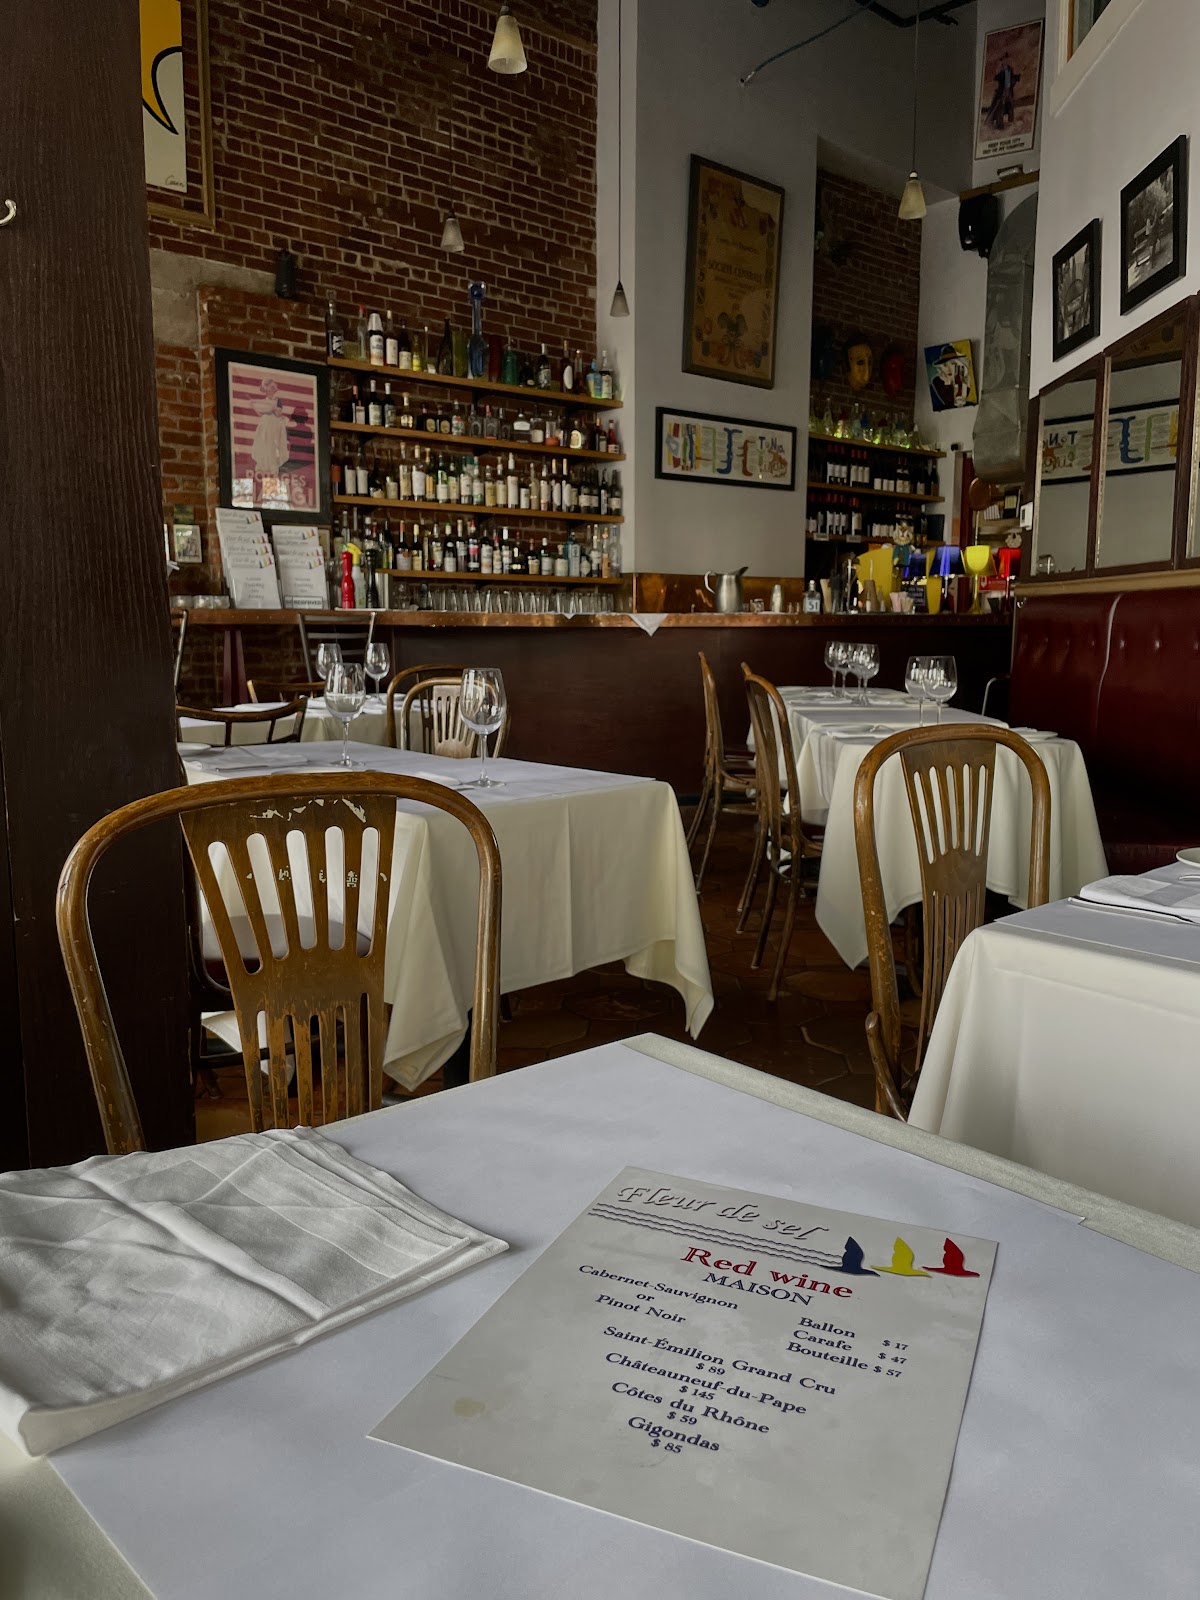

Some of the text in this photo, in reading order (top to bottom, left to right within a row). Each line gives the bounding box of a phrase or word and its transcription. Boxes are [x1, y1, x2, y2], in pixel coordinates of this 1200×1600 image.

[618, 1185, 830, 1241] Fleur de sel
[578, 1264, 739, 1311] Cabernet-Sauvignon
[680, 1246, 854, 1299] Red wine
[702, 1272, 814, 1306] MAISON
[595, 1294, 687, 1325] Pinot Noir
[636, 1291, 655, 1303] or
[793, 1329, 907, 1365] Carafe $ 47
[798, 1317, 909, 1351] Ballon $ 17
[603, 1325, 837, 1396] Saint-Émilion Grand Cru
[695, 1361, 726, 1376] $ 89
[785, 1341, 902, 1378] Bouteille $ 57
[605, 1351, 808, 1416] Châteauneuf-du-Pape
[679, 1385, 715, 1401] $ 145
[611, 1381, 771, 1435] Côtes du Rhône
[667, 1411, 698, 1426] $ 59
[627, 1415, 721, 1452] Gigondas
[650, 1437, 684, 1454] $ 85
